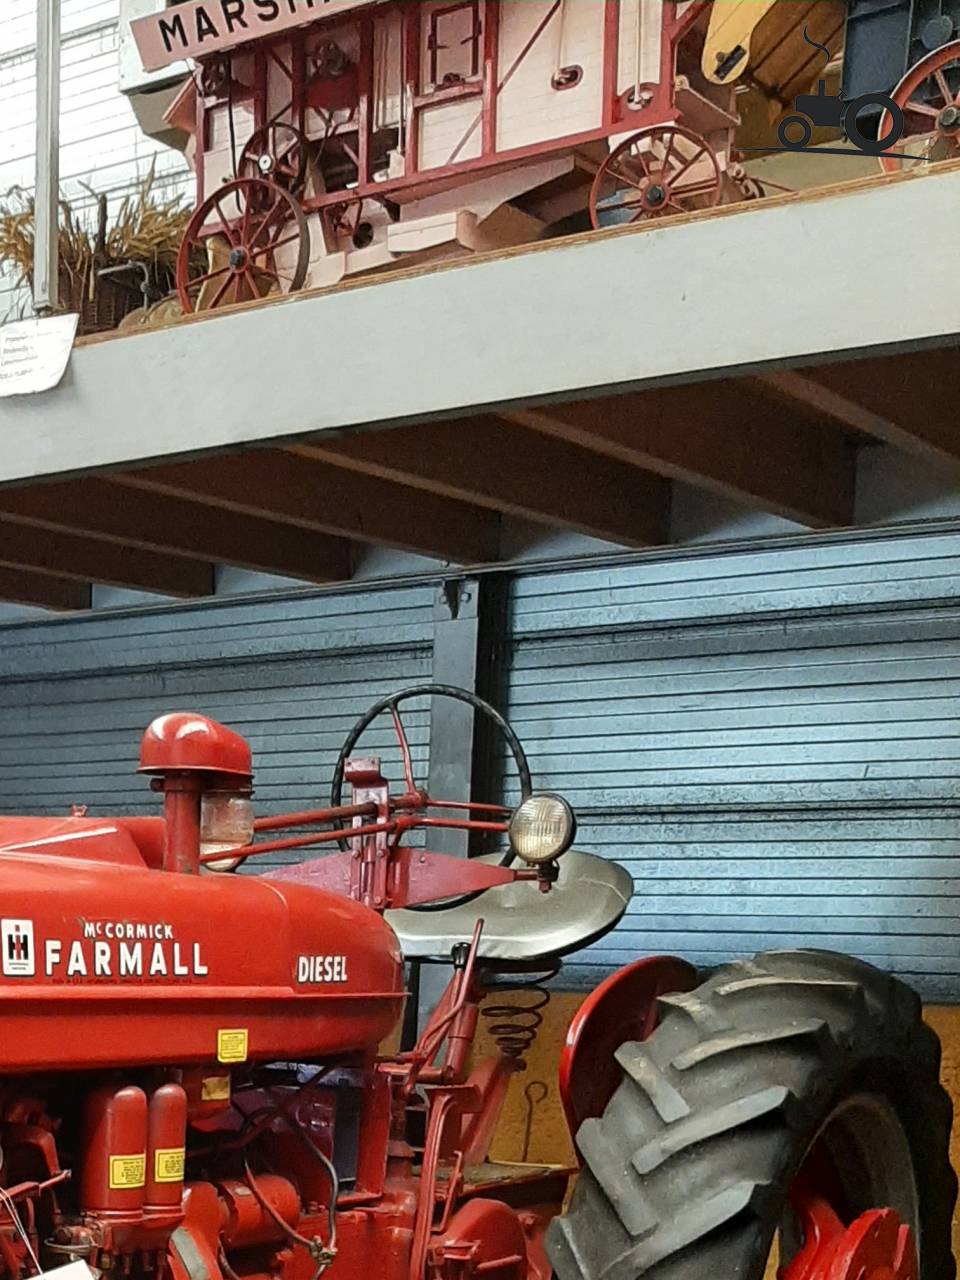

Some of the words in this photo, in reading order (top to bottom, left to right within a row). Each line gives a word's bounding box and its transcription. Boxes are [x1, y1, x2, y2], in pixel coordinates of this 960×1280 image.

[158, 0, 332, 53] MARS
[45, 940, 209, 976] FARMALL
[298, 955, 348, 982] DIESEL
